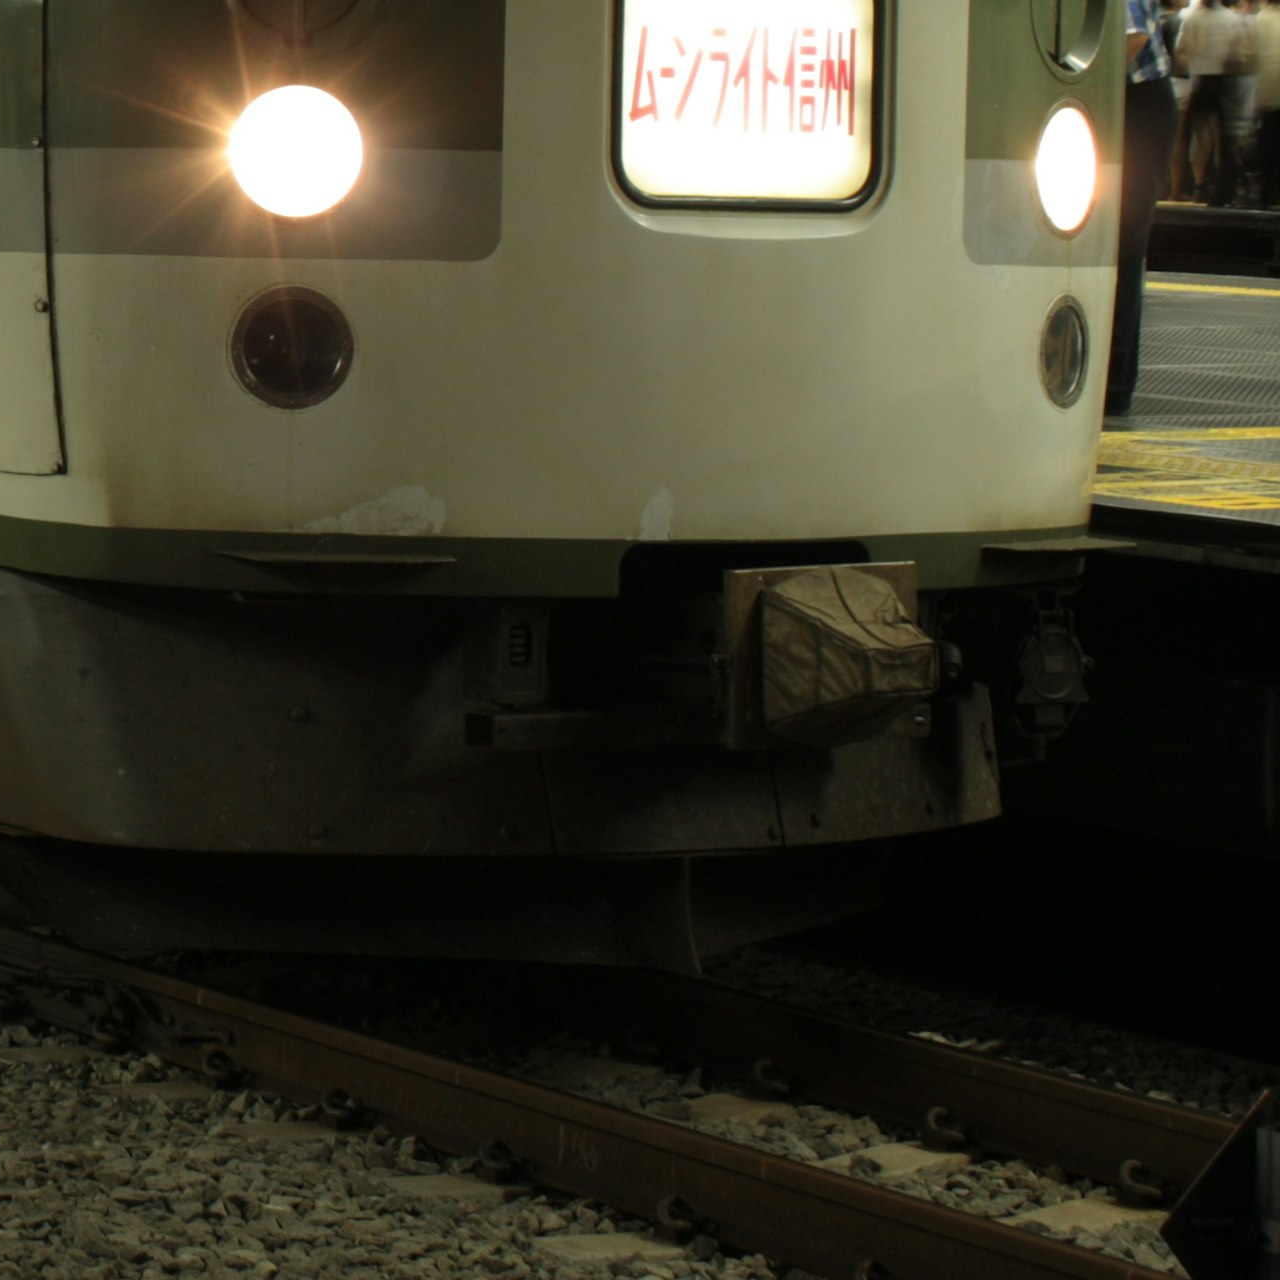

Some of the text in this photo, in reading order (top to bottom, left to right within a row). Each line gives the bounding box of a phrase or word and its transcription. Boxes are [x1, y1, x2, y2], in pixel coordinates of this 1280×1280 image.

[628, 25, 857, 137] ムーンライト信州
